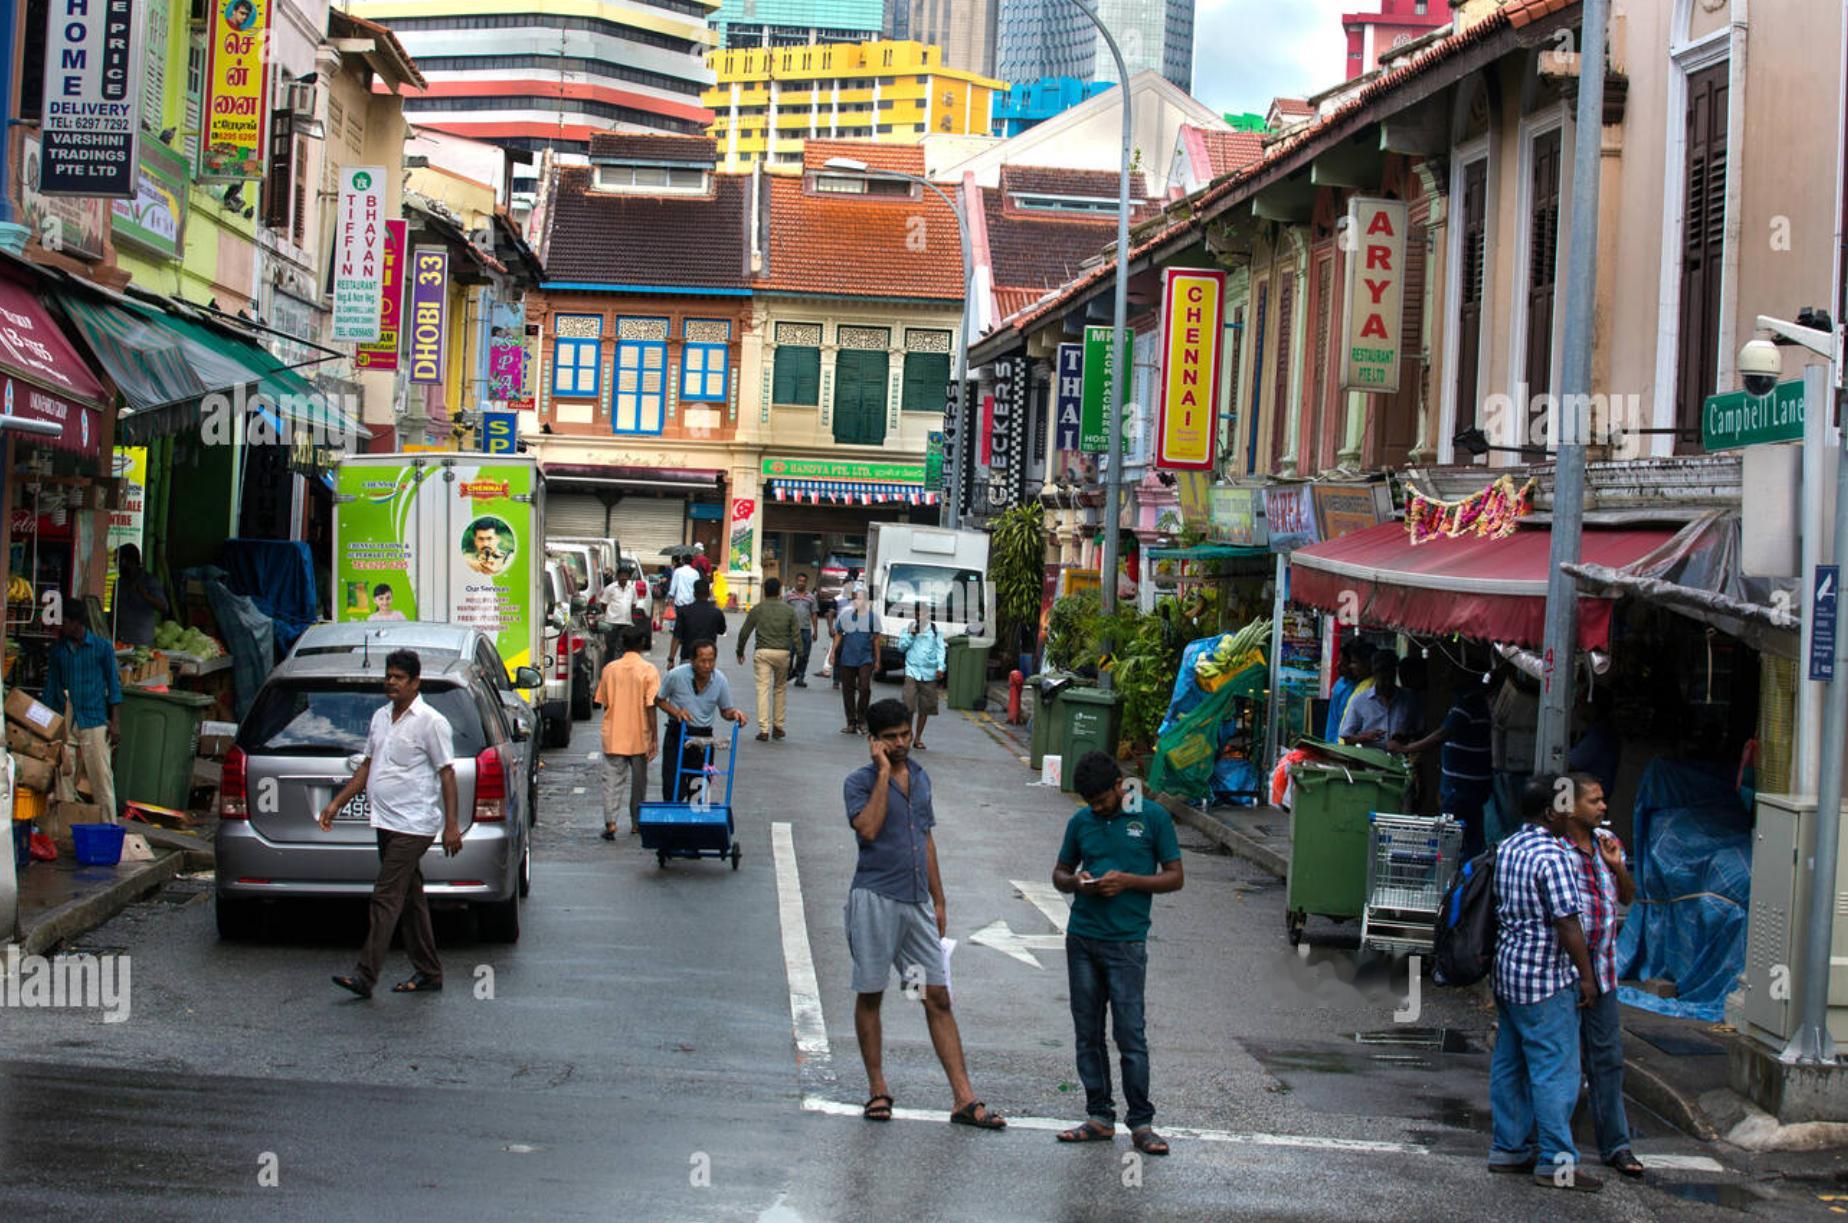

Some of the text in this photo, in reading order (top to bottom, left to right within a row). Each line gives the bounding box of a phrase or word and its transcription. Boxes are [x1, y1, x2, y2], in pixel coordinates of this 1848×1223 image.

[61, 0, 88, 96] HOME
[107, 23, 126, 95] PRICE
[50, 101, 130, 117] DELIVERY
[50, 116, 130, 130] TEL: 6297 7292
[52, 132, 124, 146] VARSHINI
[49, 148, 127, 162] TRADINGS
[56, 164, 117, 177] PTE LTD
[342, 194, 356, 276] TIFFIN
[363, 195, 377, 277] BHAVAN
[1360, 211, 1394, 339] ARYA
[414, 255, 443, 380] DHOBI 33
[1181, 286, 1203, 427] CHENNAI
[1352, 347, 1394, 365] RESTAURANT
[988, 361, 1012, 506] CHECKERS
[1059, 350, 1082, 451] THAI
[1710, 392, 1804, 440] Campbell Lane
[338, 802, 371, 817] 499
